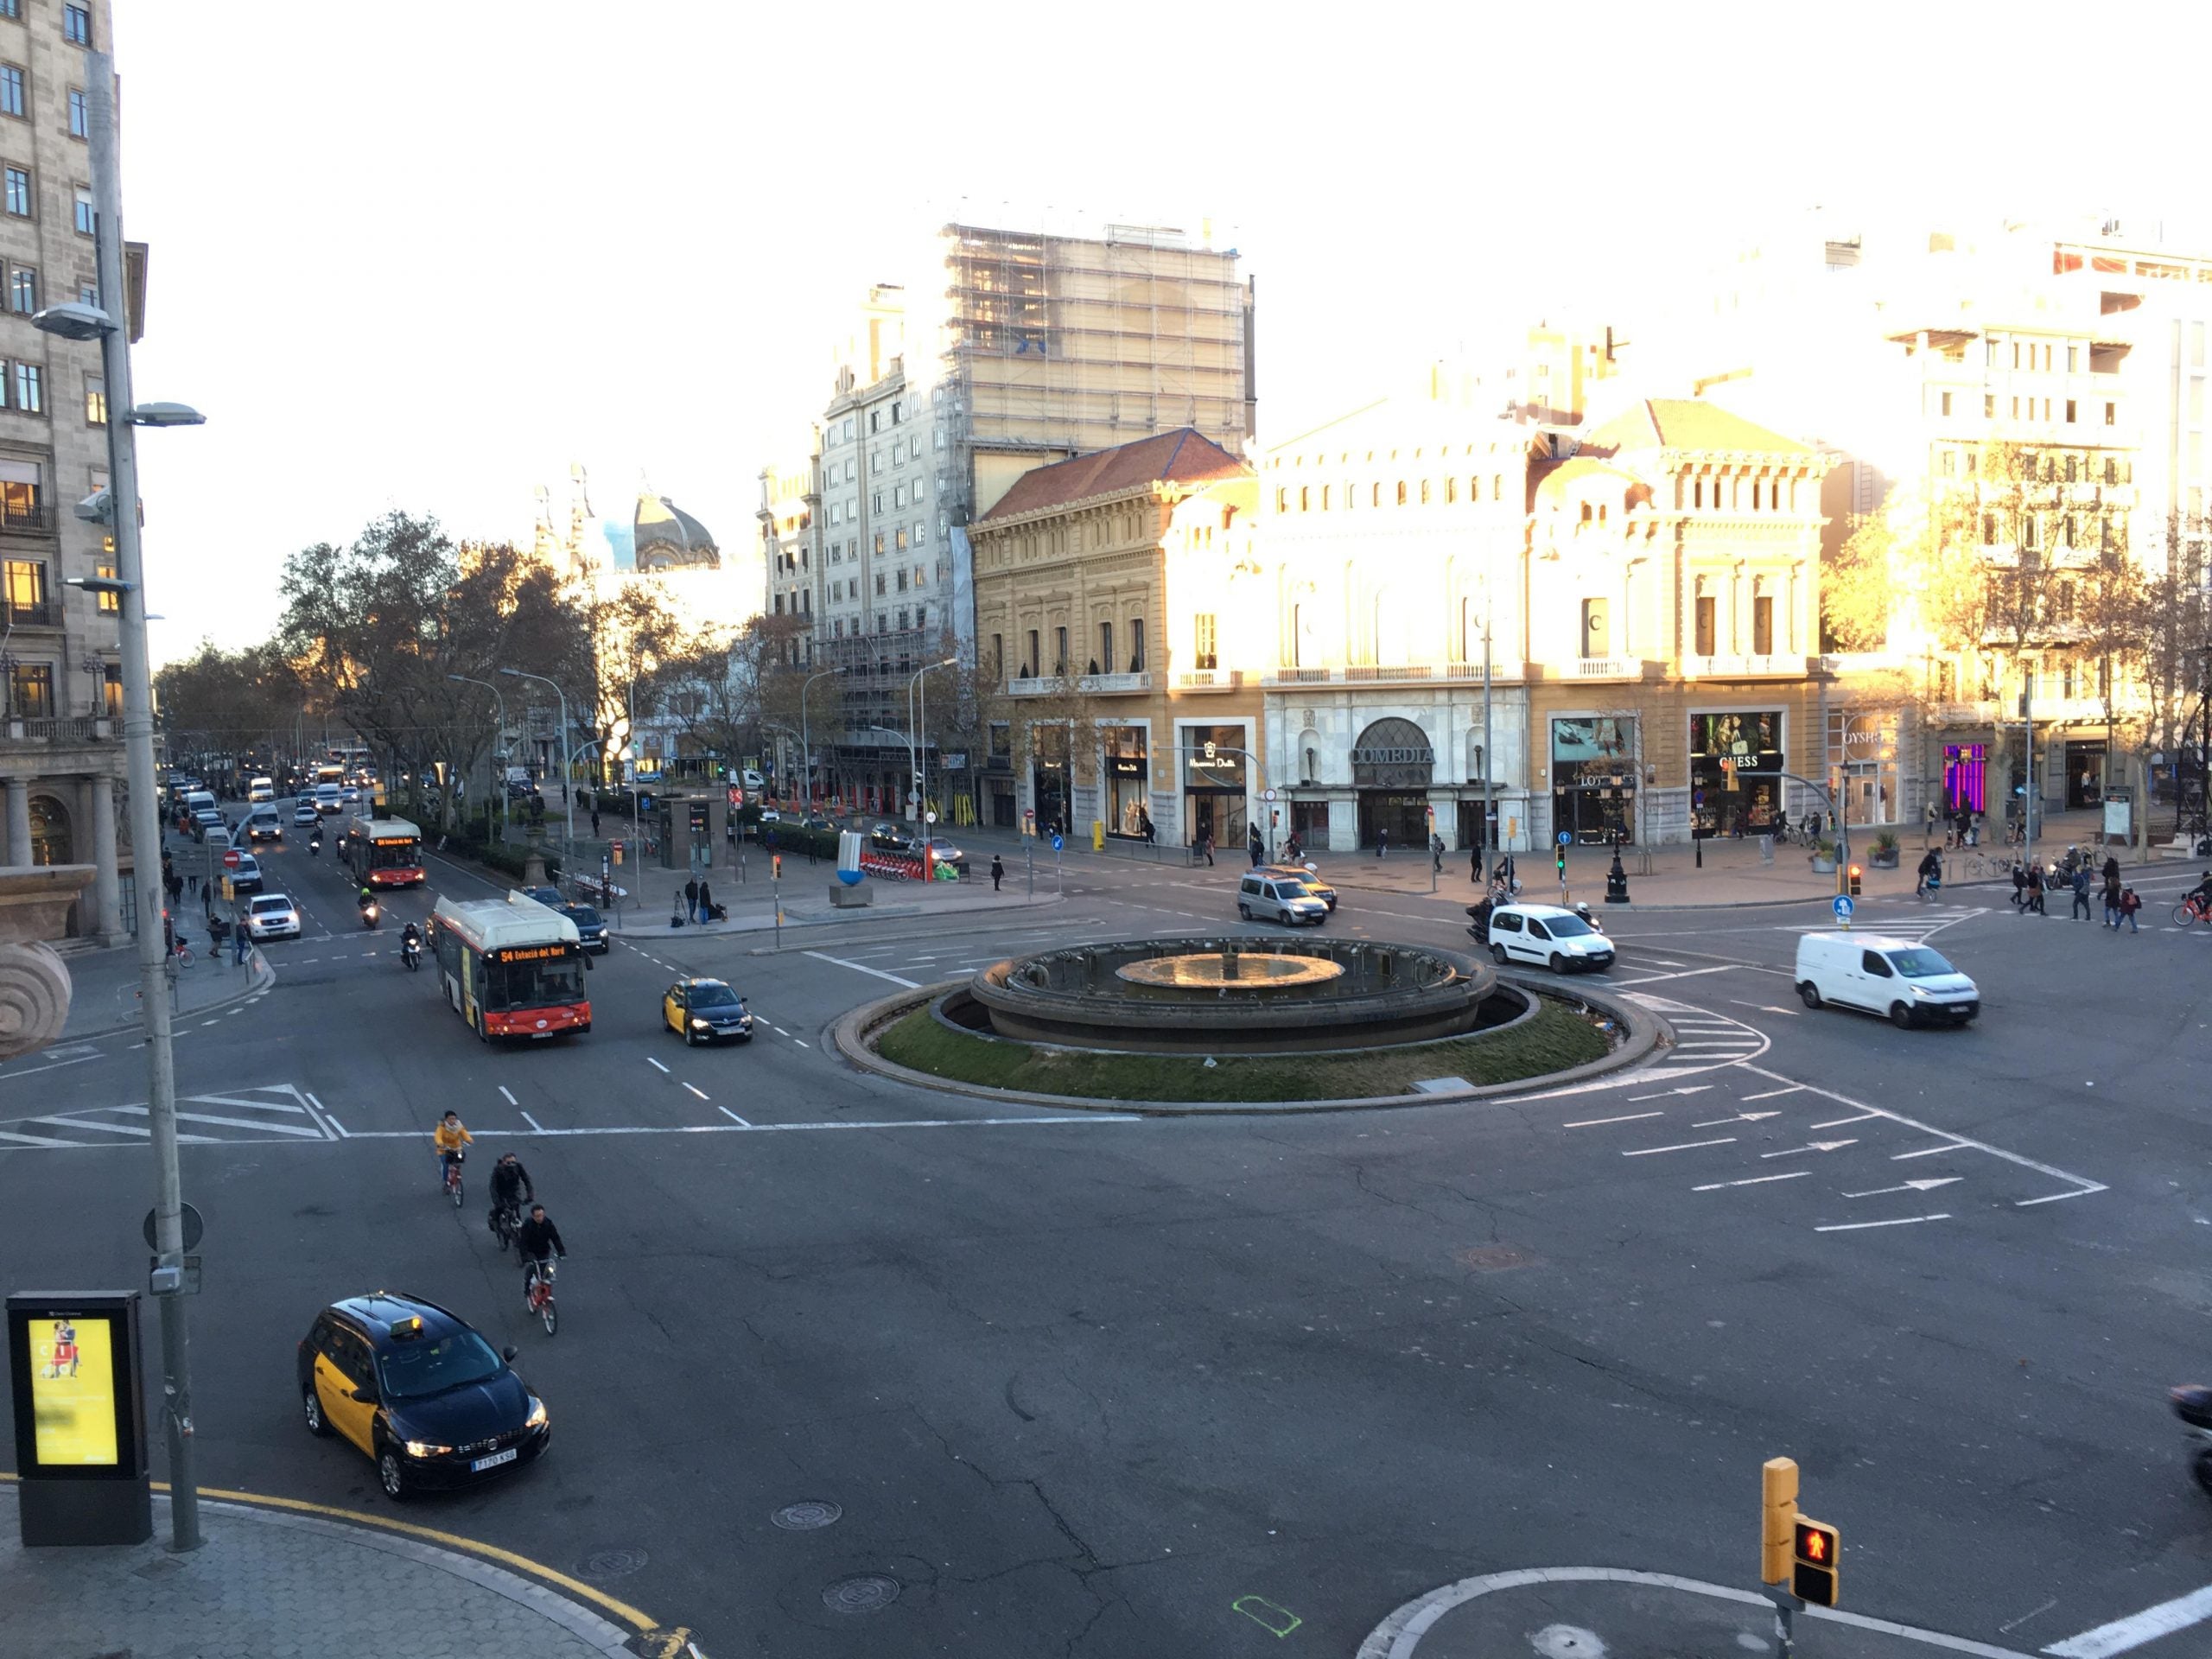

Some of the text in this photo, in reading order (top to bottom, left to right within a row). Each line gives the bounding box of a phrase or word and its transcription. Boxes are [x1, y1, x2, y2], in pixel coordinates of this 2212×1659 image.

[1349, 747, 1436, 765] COMEDIA
[501, 950, 513, 963] 54
[539, 948, 549, 957] del
